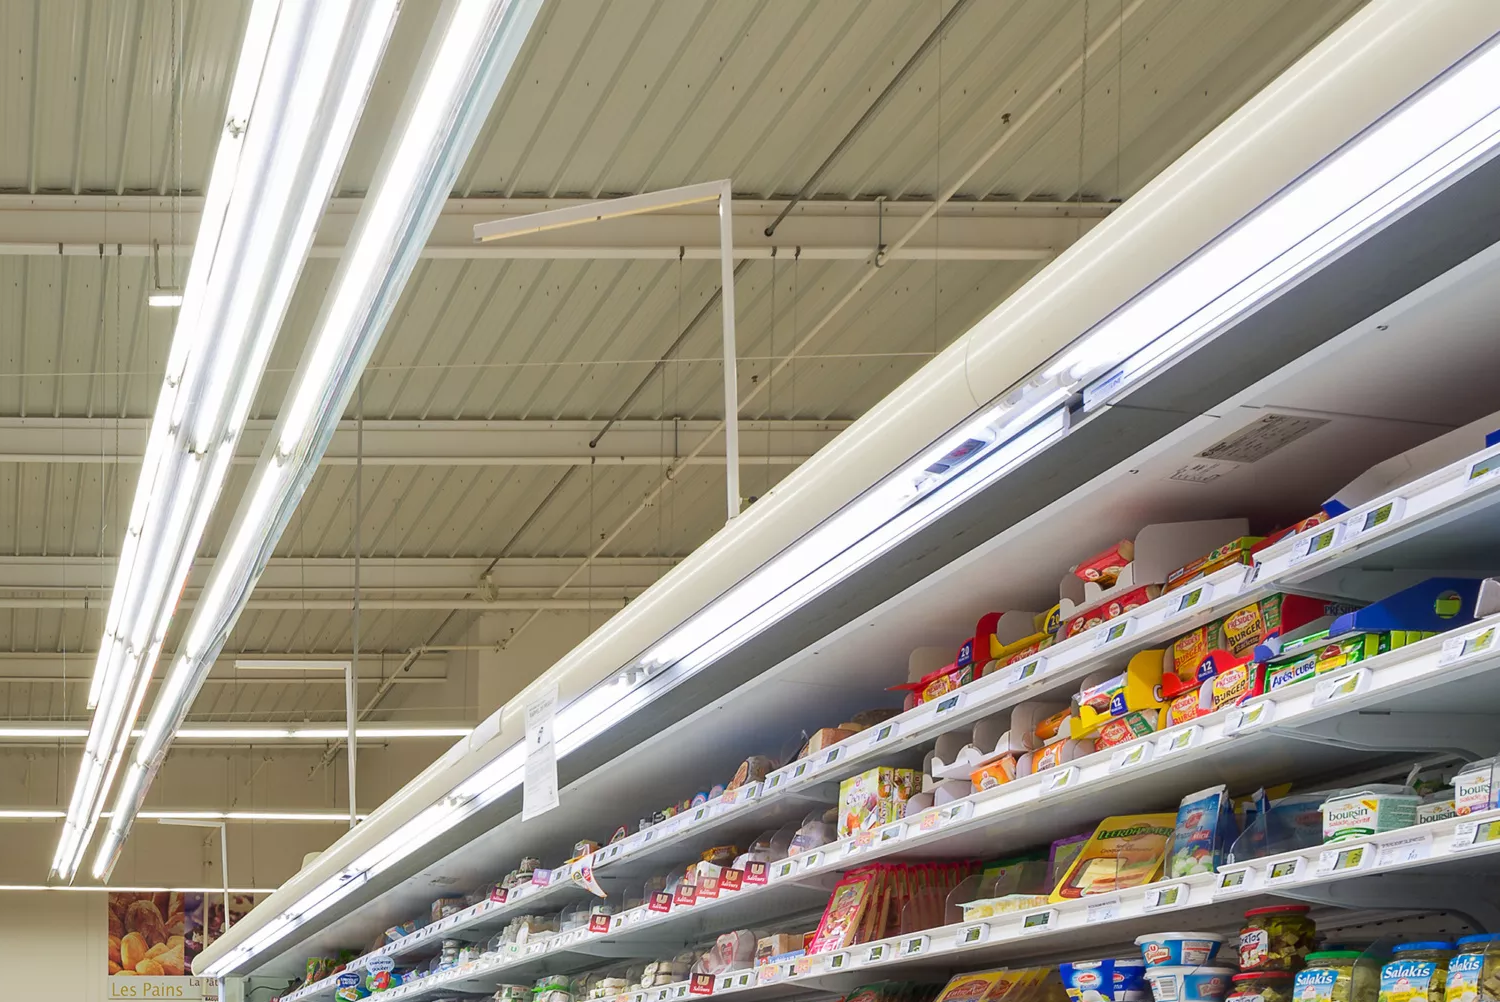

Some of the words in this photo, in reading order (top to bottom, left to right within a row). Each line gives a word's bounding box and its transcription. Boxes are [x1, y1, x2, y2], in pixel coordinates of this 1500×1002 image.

[1227, 610, 1257, 629] PRÉSIDENT
[1229, 619, 1261, 648] BURGER
[1175, 642, 1203, 667] BURGER
[1201, 660, 1212, 671] 12
[1215, 671, 1244, 688] PRÉSIDENT
[1214, 680, 1246, 705] BURGER
[1113, 697, 1121, 707] 12
[1460, 785, 1490, 798] bours
[1329, 808, 1368, 821] boursin
[1296, 970, 1334, 986] Salakis
[1383, 962, 1430, 979] Salakis
[112, 982, 136, 997] Les
[143, 982, 183, 997] Pains
[189, 978, 201, 987] La
